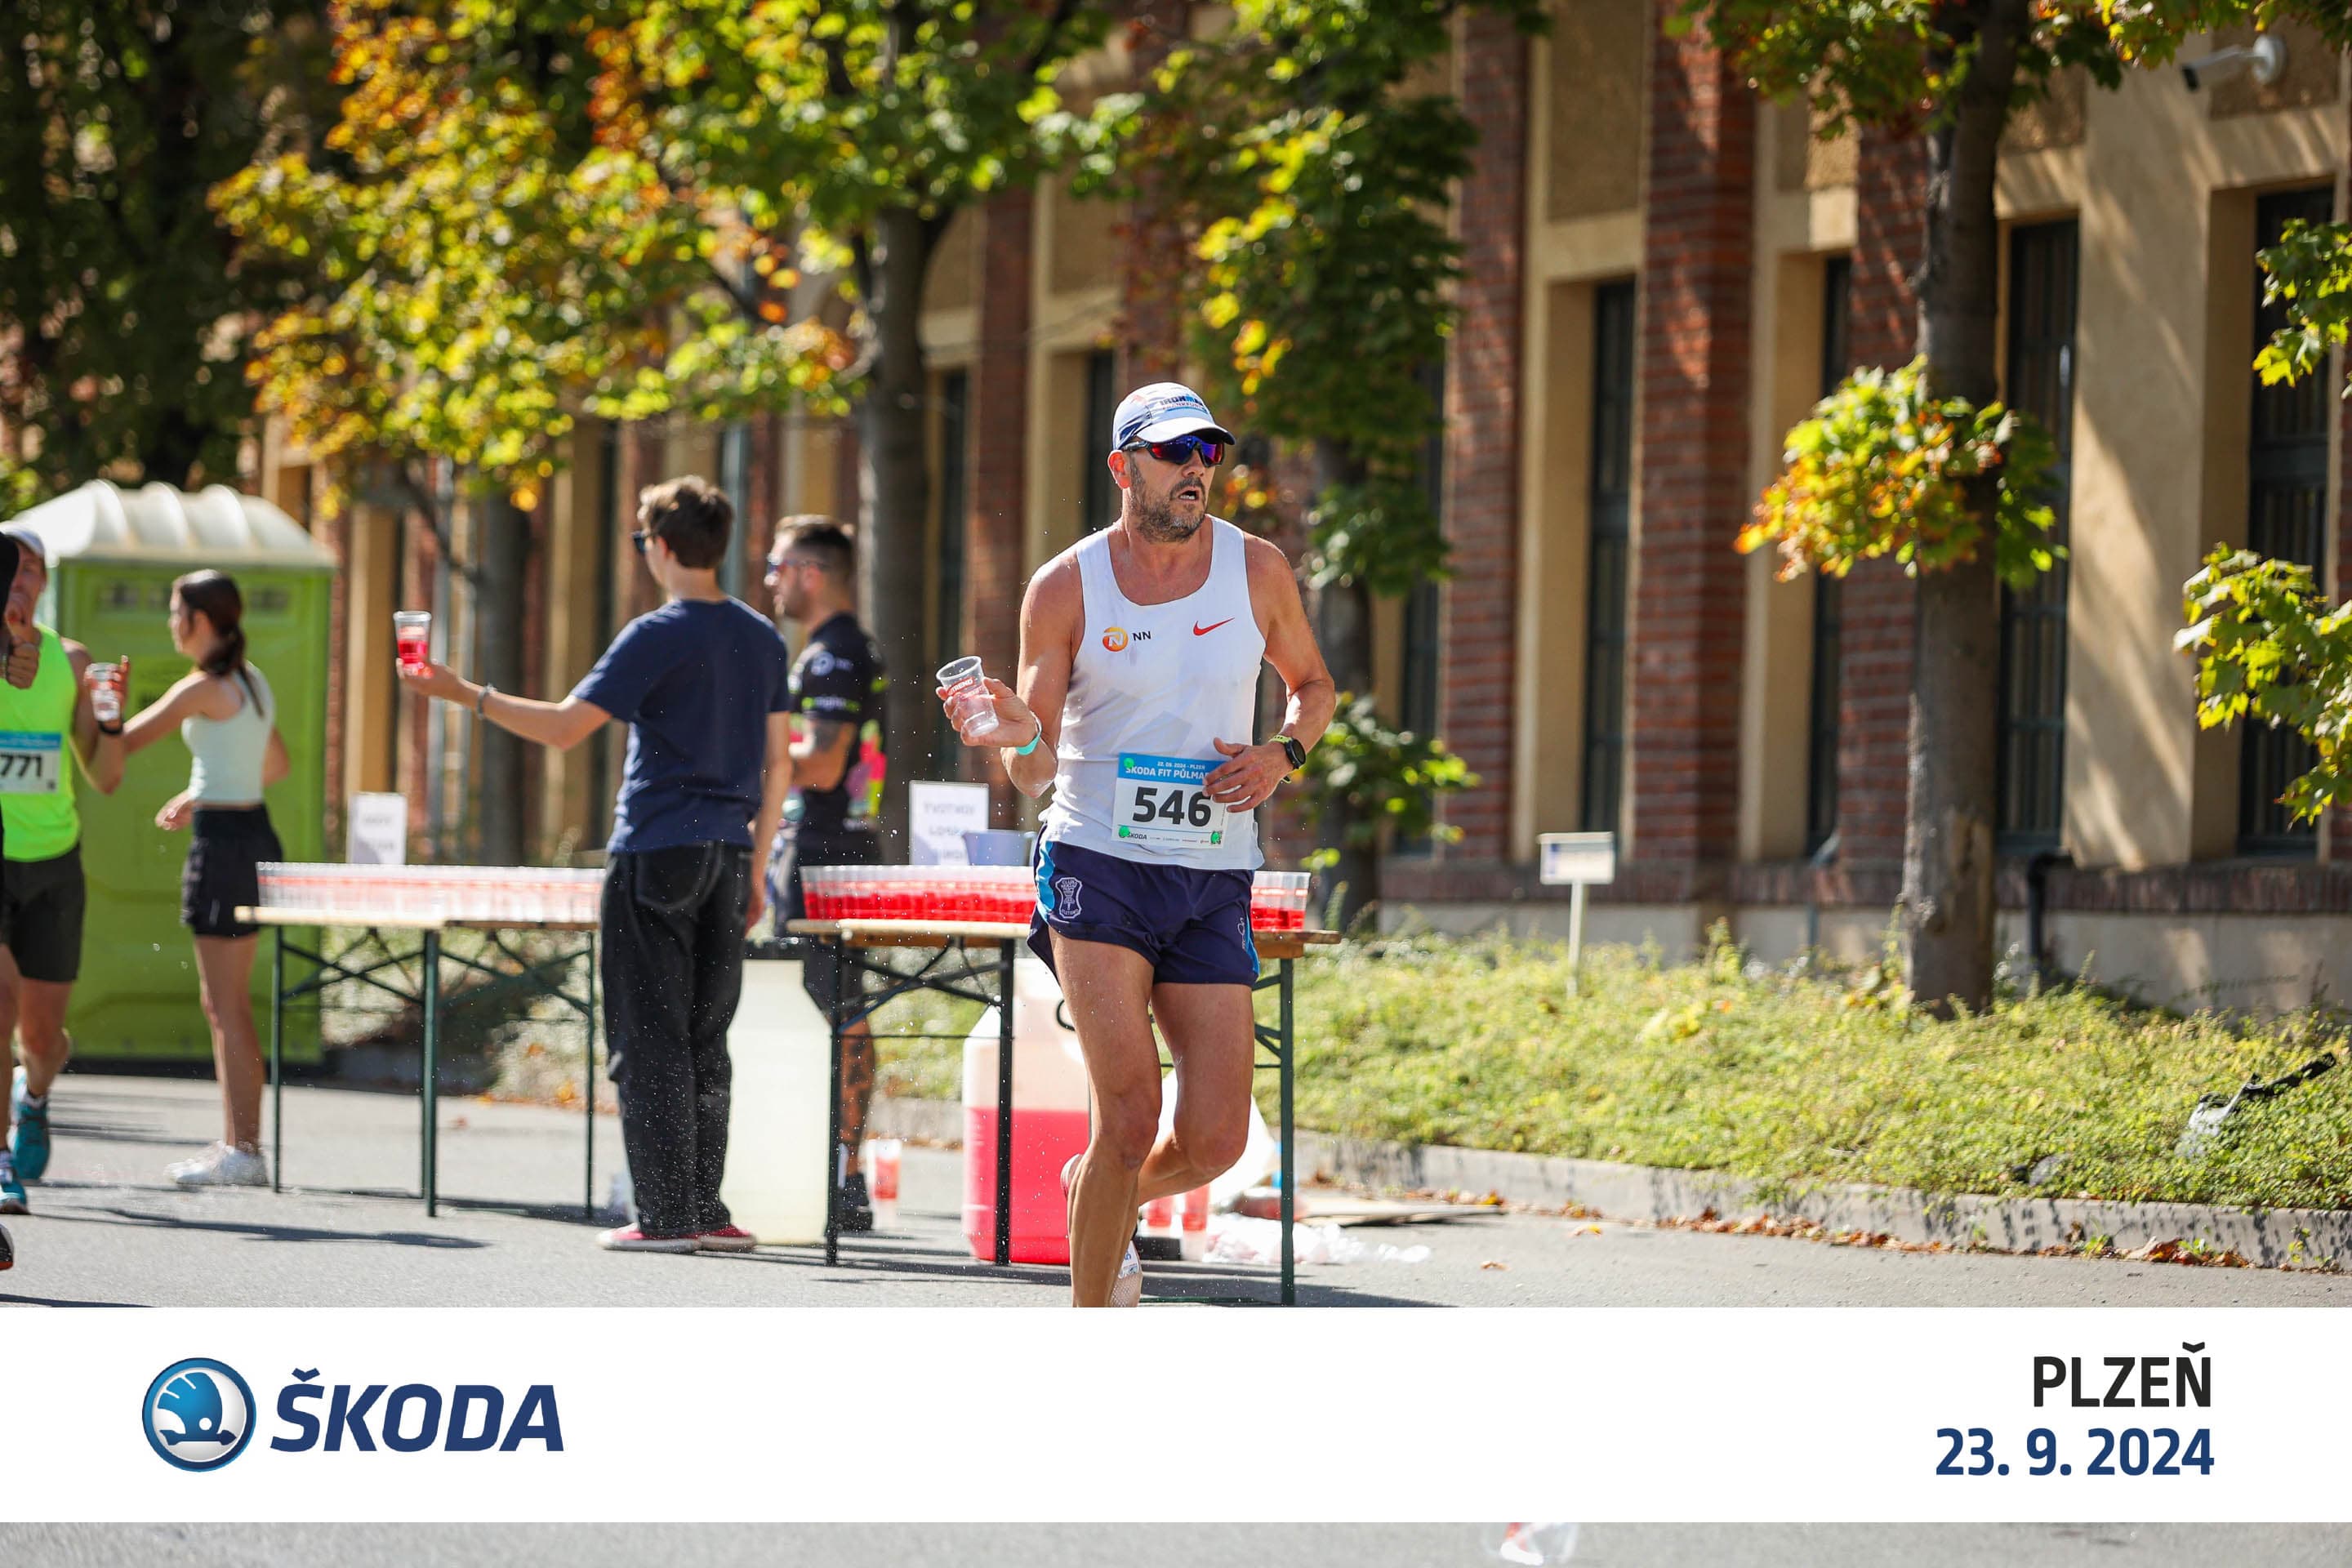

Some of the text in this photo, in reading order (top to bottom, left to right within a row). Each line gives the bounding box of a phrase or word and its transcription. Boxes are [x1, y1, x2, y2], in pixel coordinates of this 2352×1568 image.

[1132, 630, 1152, 641] NN
[0, 754, 42, 777] 771
[1158, 768, 1172, 777] FIT
[1132, 786, 1211, 827] 546
